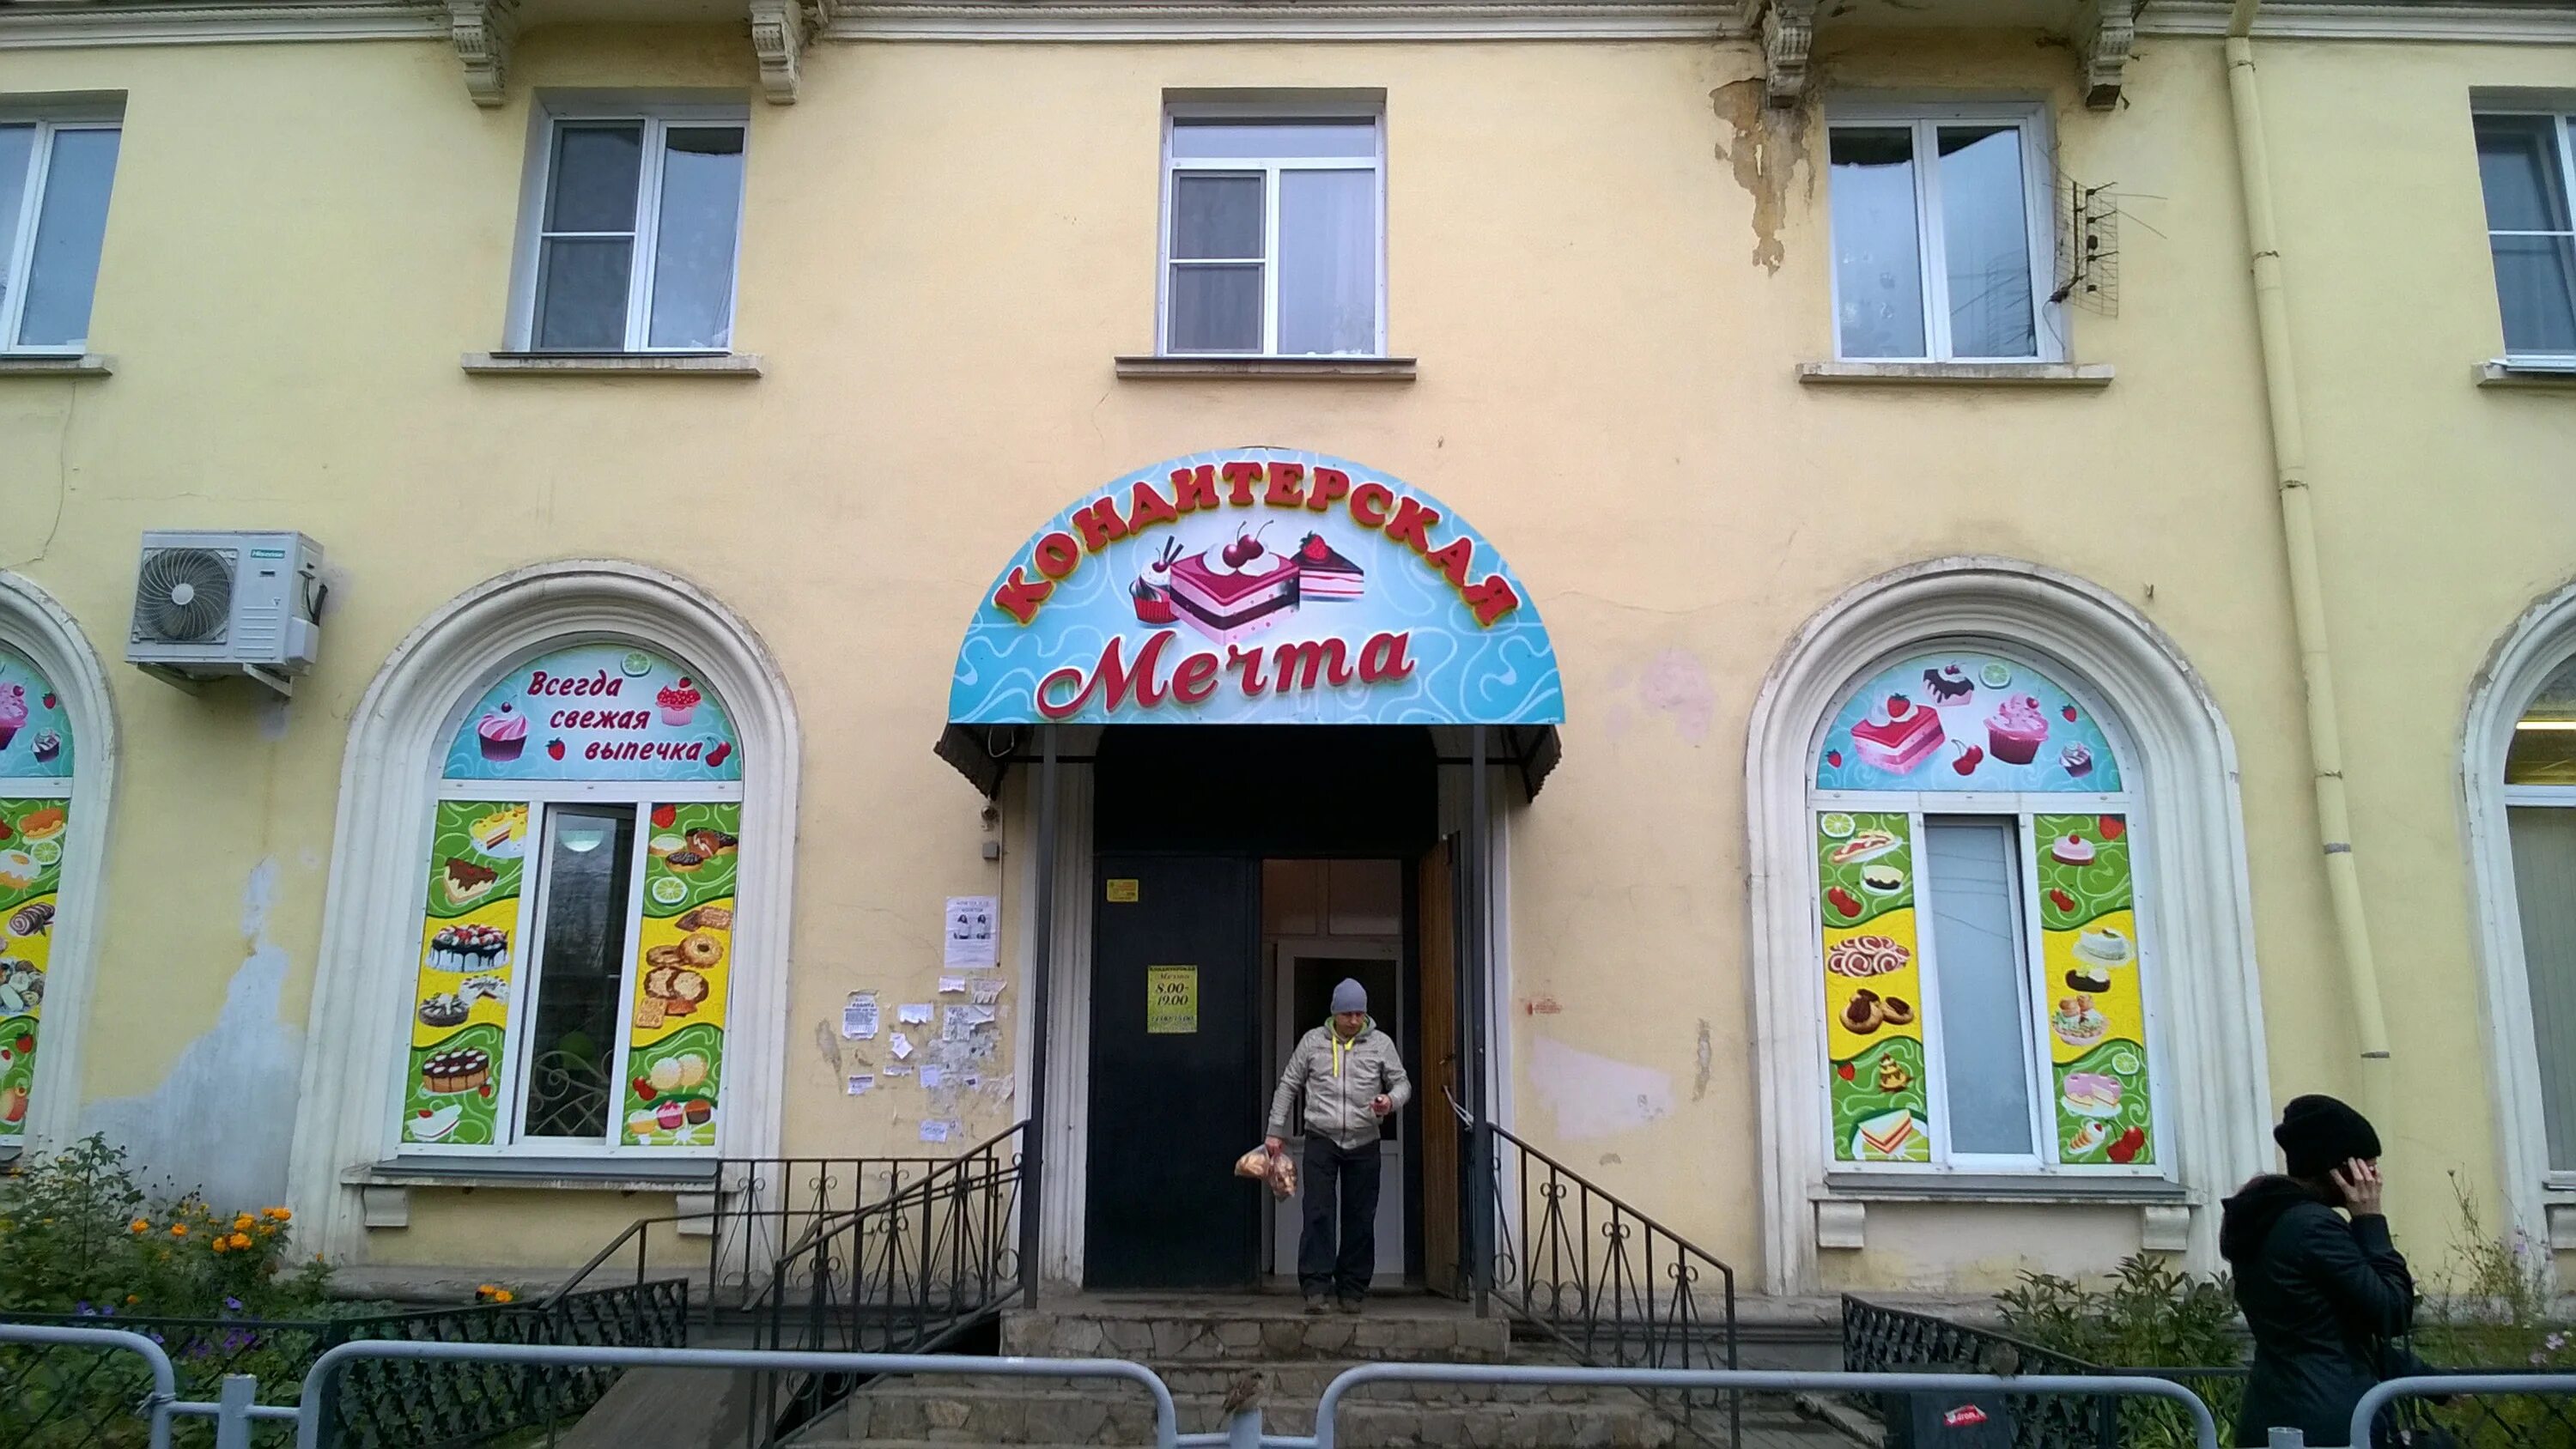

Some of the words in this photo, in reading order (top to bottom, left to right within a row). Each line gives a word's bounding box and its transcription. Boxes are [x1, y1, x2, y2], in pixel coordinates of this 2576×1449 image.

[993, 462, 1521, 627] КОНДИТЕРСКАЯ
[527, 669, 623, 697] Всегда
[1036, 629, 1415, 718] Мечта
[550, 709, 651, 730] свежая
[585, 740, 703, 761] выпечка
